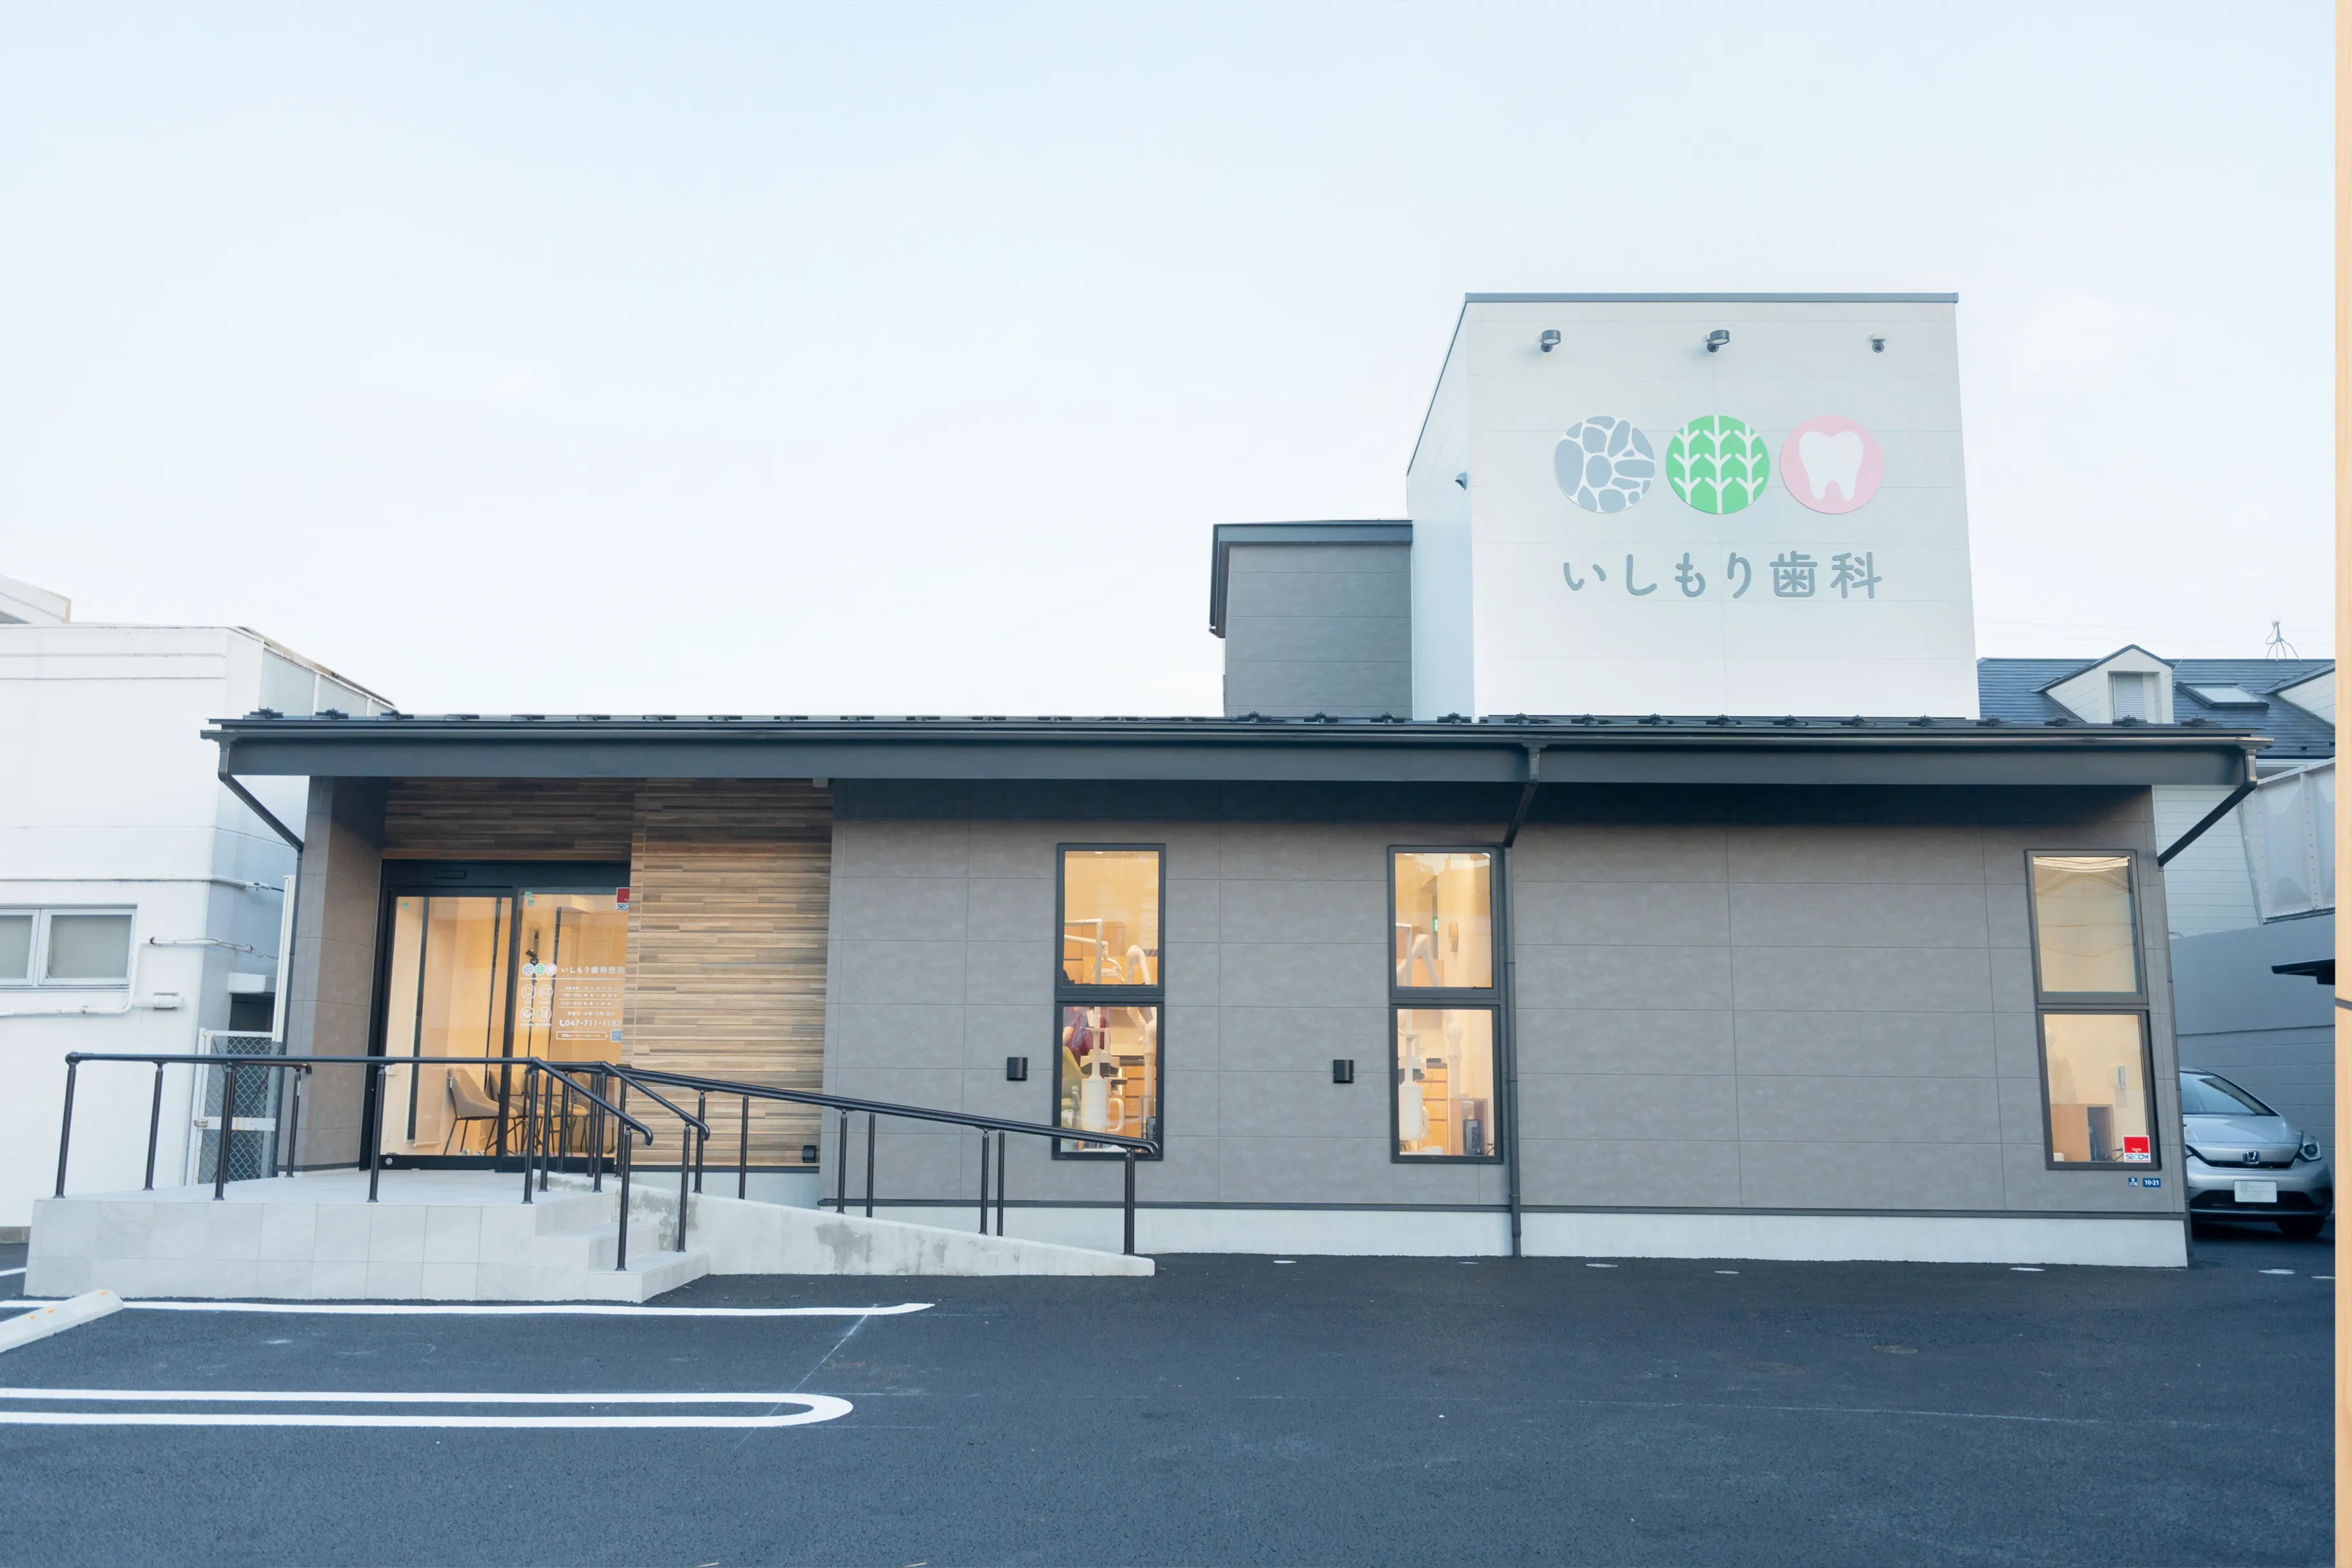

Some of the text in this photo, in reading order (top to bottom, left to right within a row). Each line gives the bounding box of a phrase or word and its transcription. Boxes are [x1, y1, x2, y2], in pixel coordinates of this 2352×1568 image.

[1562, 551, 1883, 599] いしもり歯科
